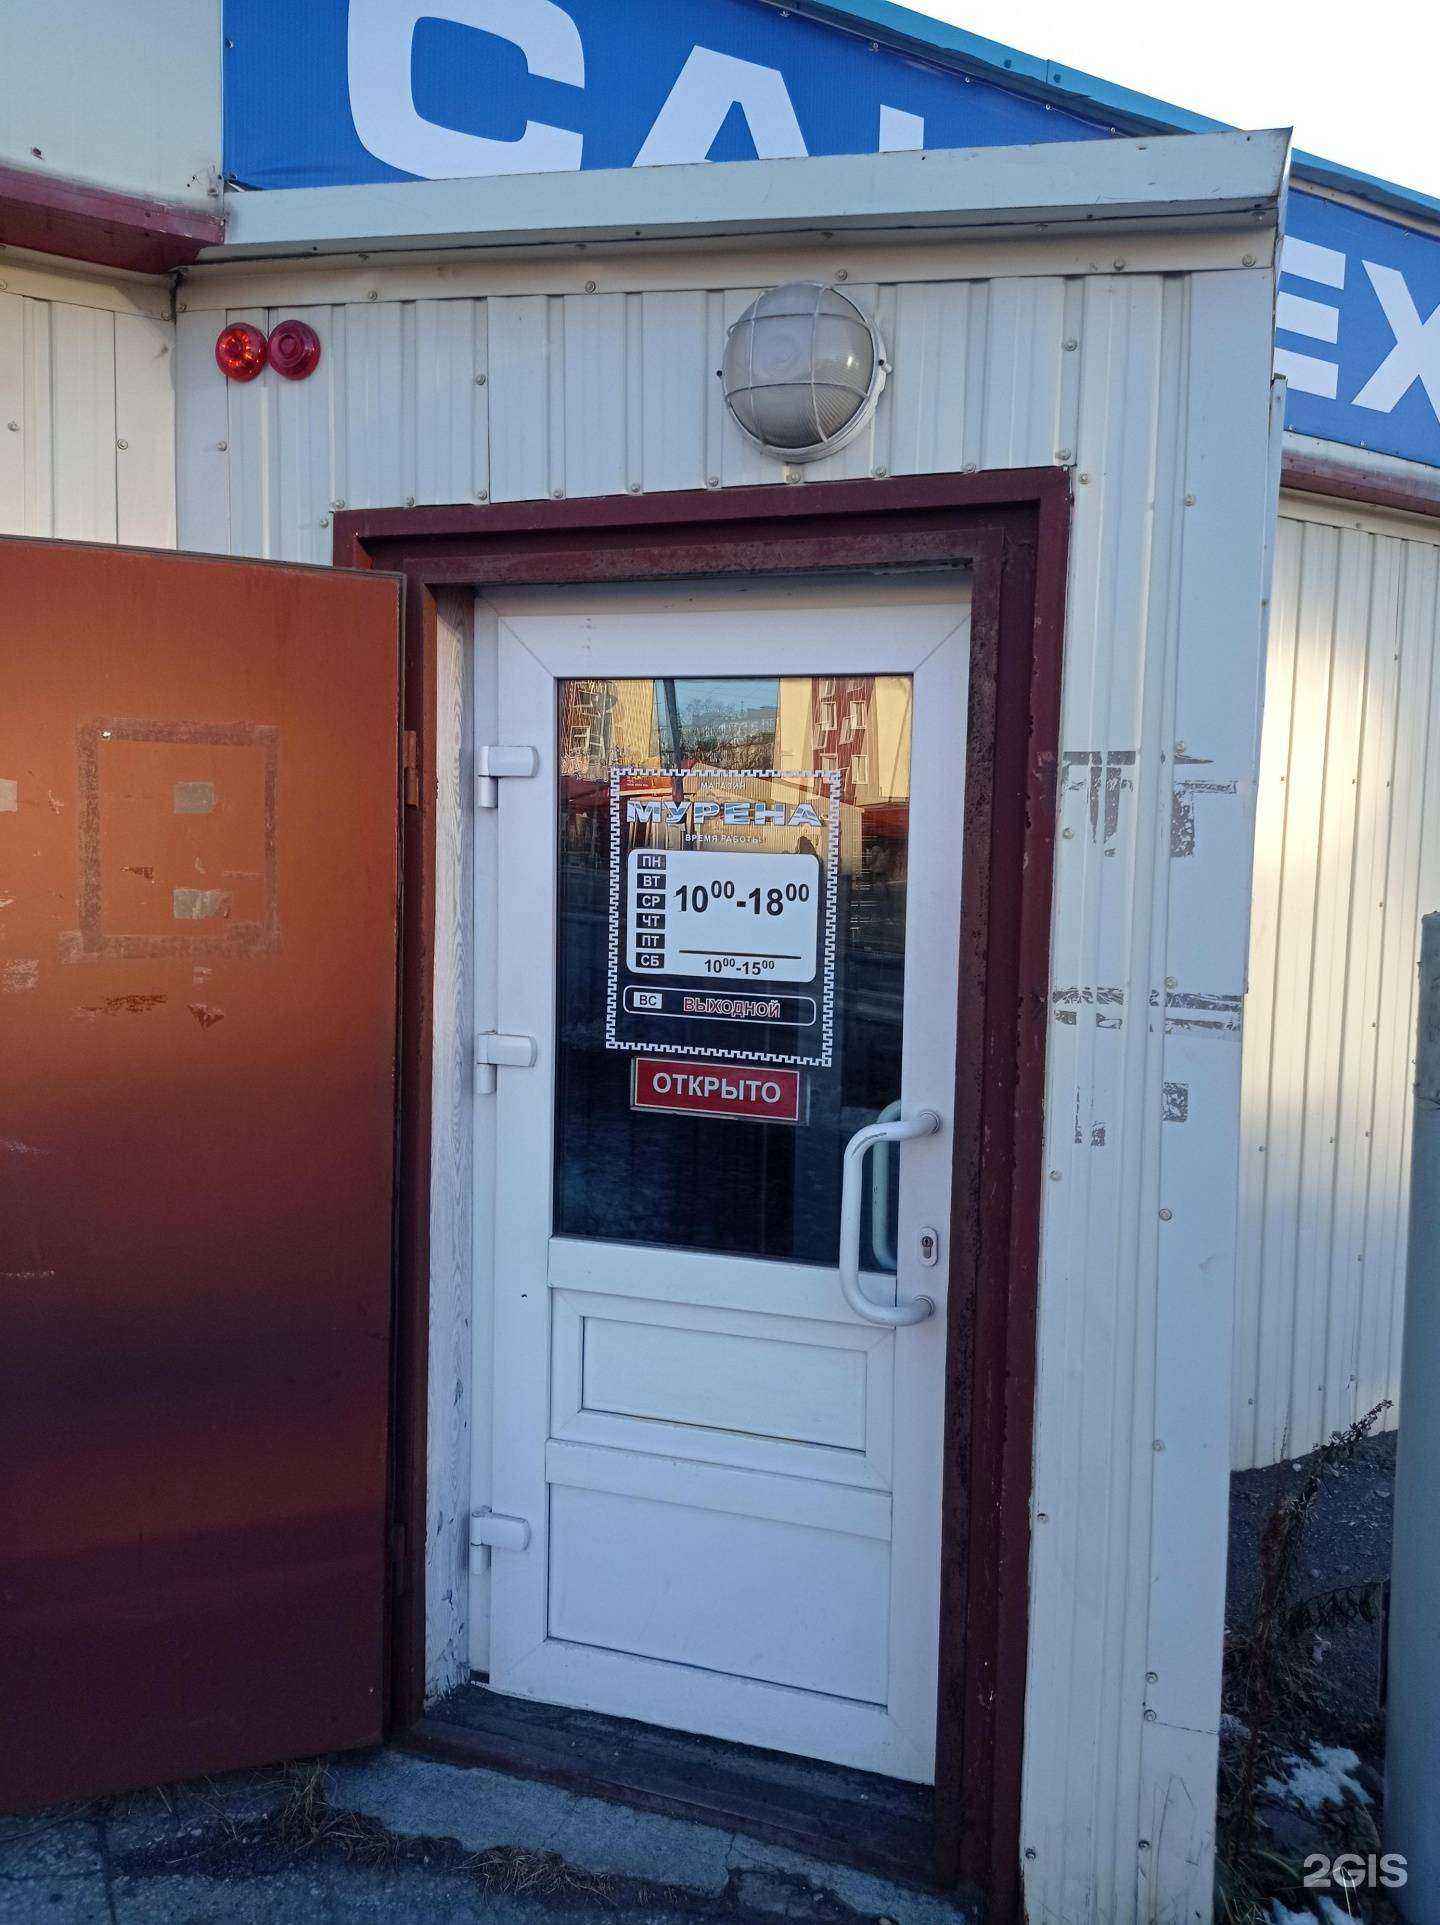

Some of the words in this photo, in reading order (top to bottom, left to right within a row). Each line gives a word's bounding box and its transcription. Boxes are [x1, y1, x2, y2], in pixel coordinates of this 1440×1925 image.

[700, 781, 746, 791] МАГАЗИН
[626, 799, 824, 827] МУРЕНА
[685, 833, 718, 843] ВРЕМЯ
[641, 855, 662, 868] ПН
[643, 875, 661, 887] ВТ
[641, 895, 661, 907] СР
[642, 915, 660, 927] ЧТ
[641, 935, 660, 947] ПТ
[640, 955, 660, 967] СБ
[639, 994, 657, 1006] ВС
[683, 996, 781, 1018] ВЫХОДНОЙ
[652, 1072, 781, 1104] ОТКРЫТО
